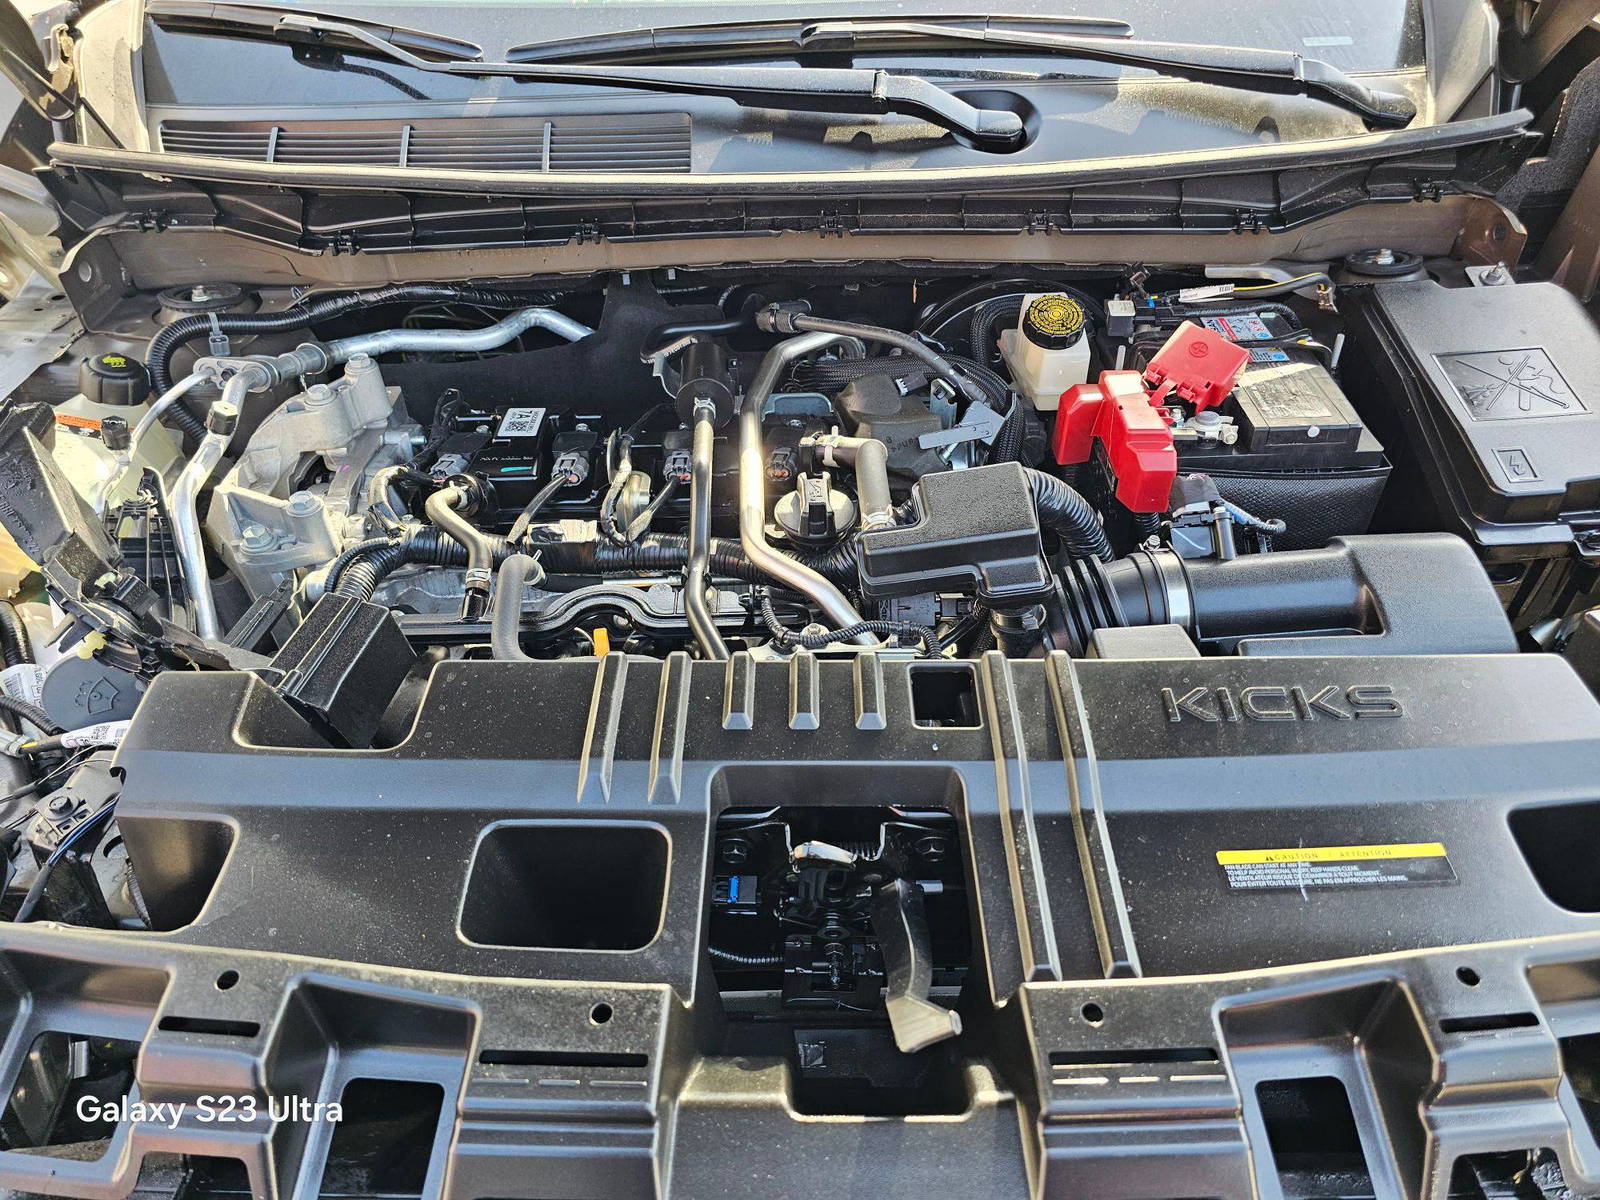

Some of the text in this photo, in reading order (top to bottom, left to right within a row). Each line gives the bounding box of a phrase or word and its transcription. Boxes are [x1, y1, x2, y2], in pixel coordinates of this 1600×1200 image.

[1161, 685, 1403, 722] KICKS
[1275, 852, 1318, 860] CAUTION
[1340, 849, 1392, 857] ATTENTION
